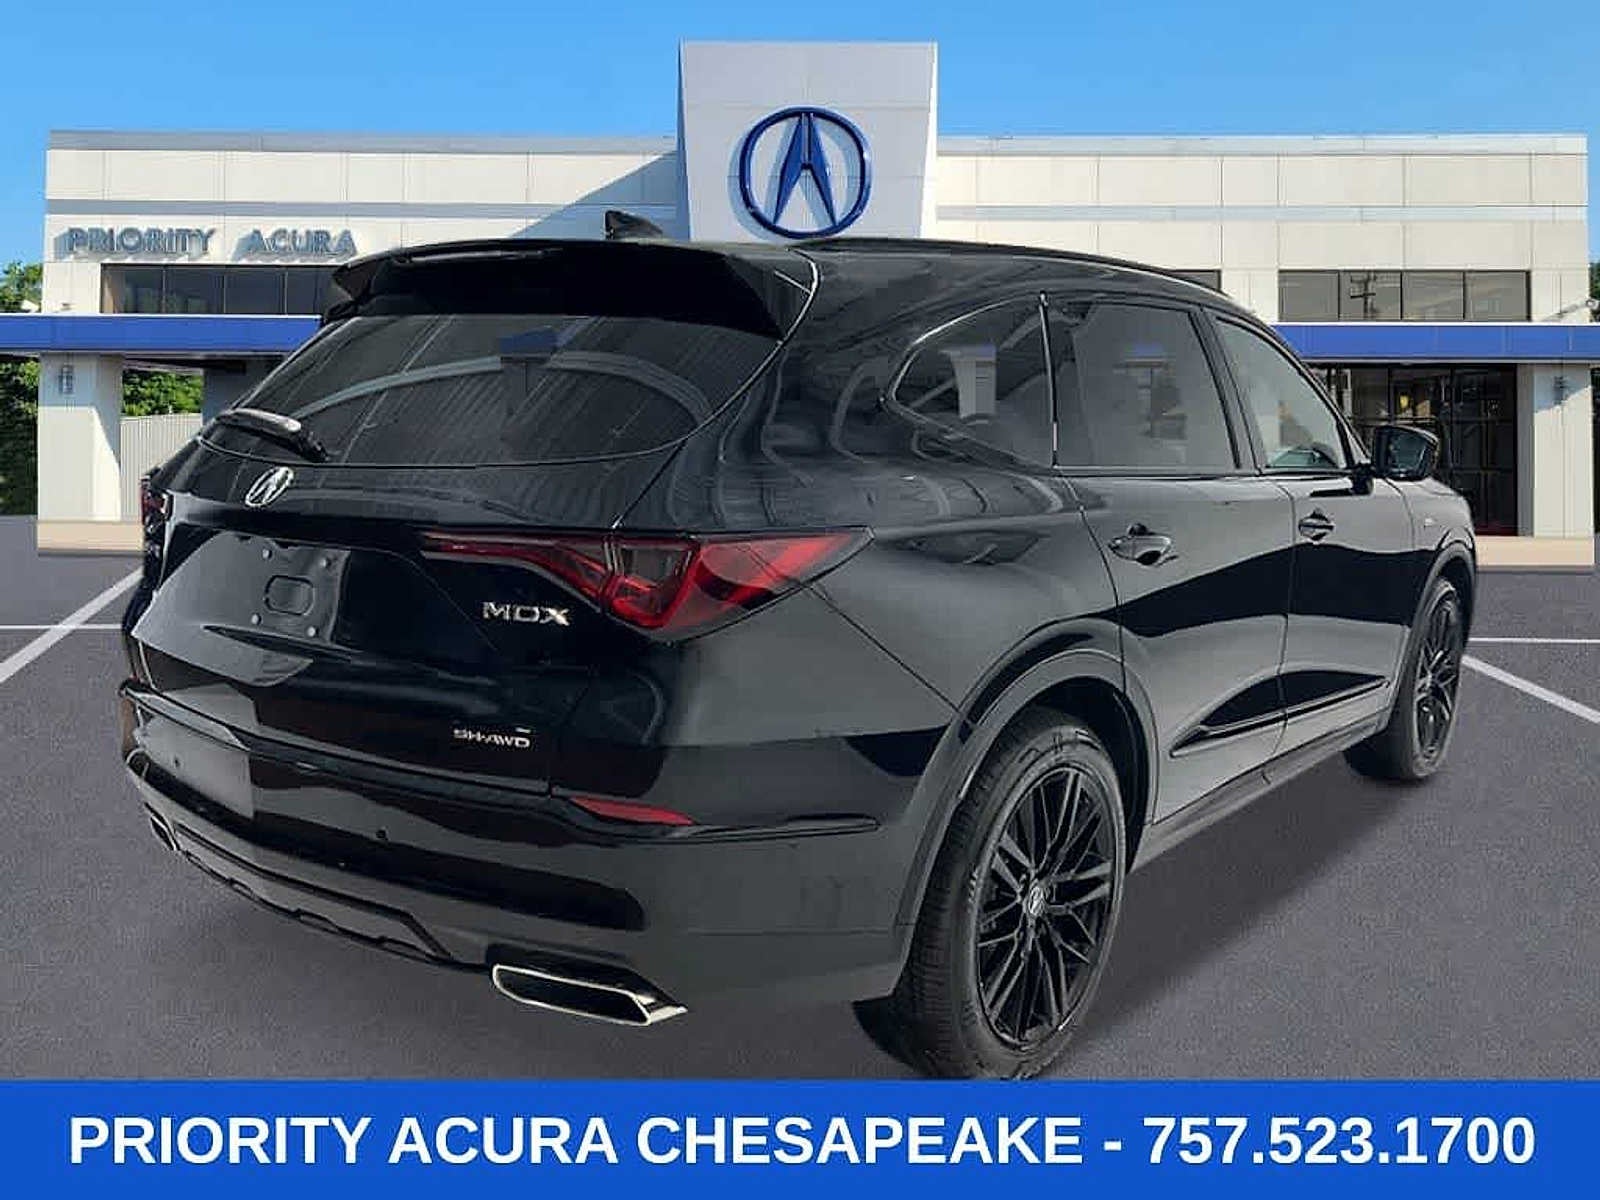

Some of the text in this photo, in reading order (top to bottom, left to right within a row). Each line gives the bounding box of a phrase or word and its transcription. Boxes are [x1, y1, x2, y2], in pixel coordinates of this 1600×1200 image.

[66, 227, 358, 254] PRIORITY ACURA
[482, 601, 570, 626] MDX
